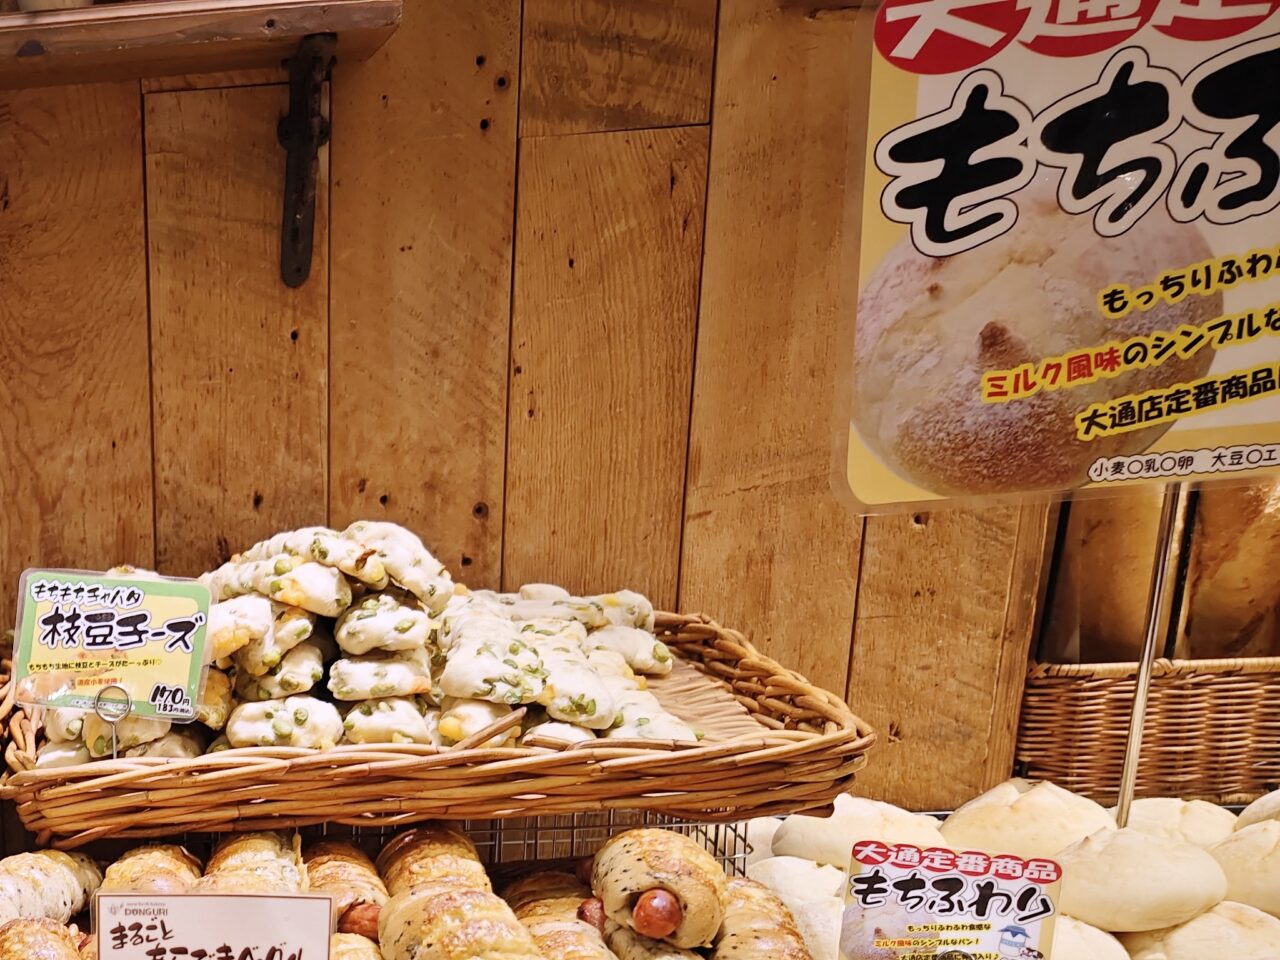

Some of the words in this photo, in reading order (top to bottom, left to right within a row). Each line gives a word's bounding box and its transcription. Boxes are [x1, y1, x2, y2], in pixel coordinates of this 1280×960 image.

[1103, 249, 1280, 313] もっちりふわ
[1080, 368, 1280, 435] 大通店定番商品
[41, 606, 203, 650] 枝豆チーズ
[854, 843, 1058, 881] 大通定番商品
[124, 907, 168, 916] DONGURI
[853, 869, 1052, 921] もちふわり
[109, 917, 174, 949] まるごと
